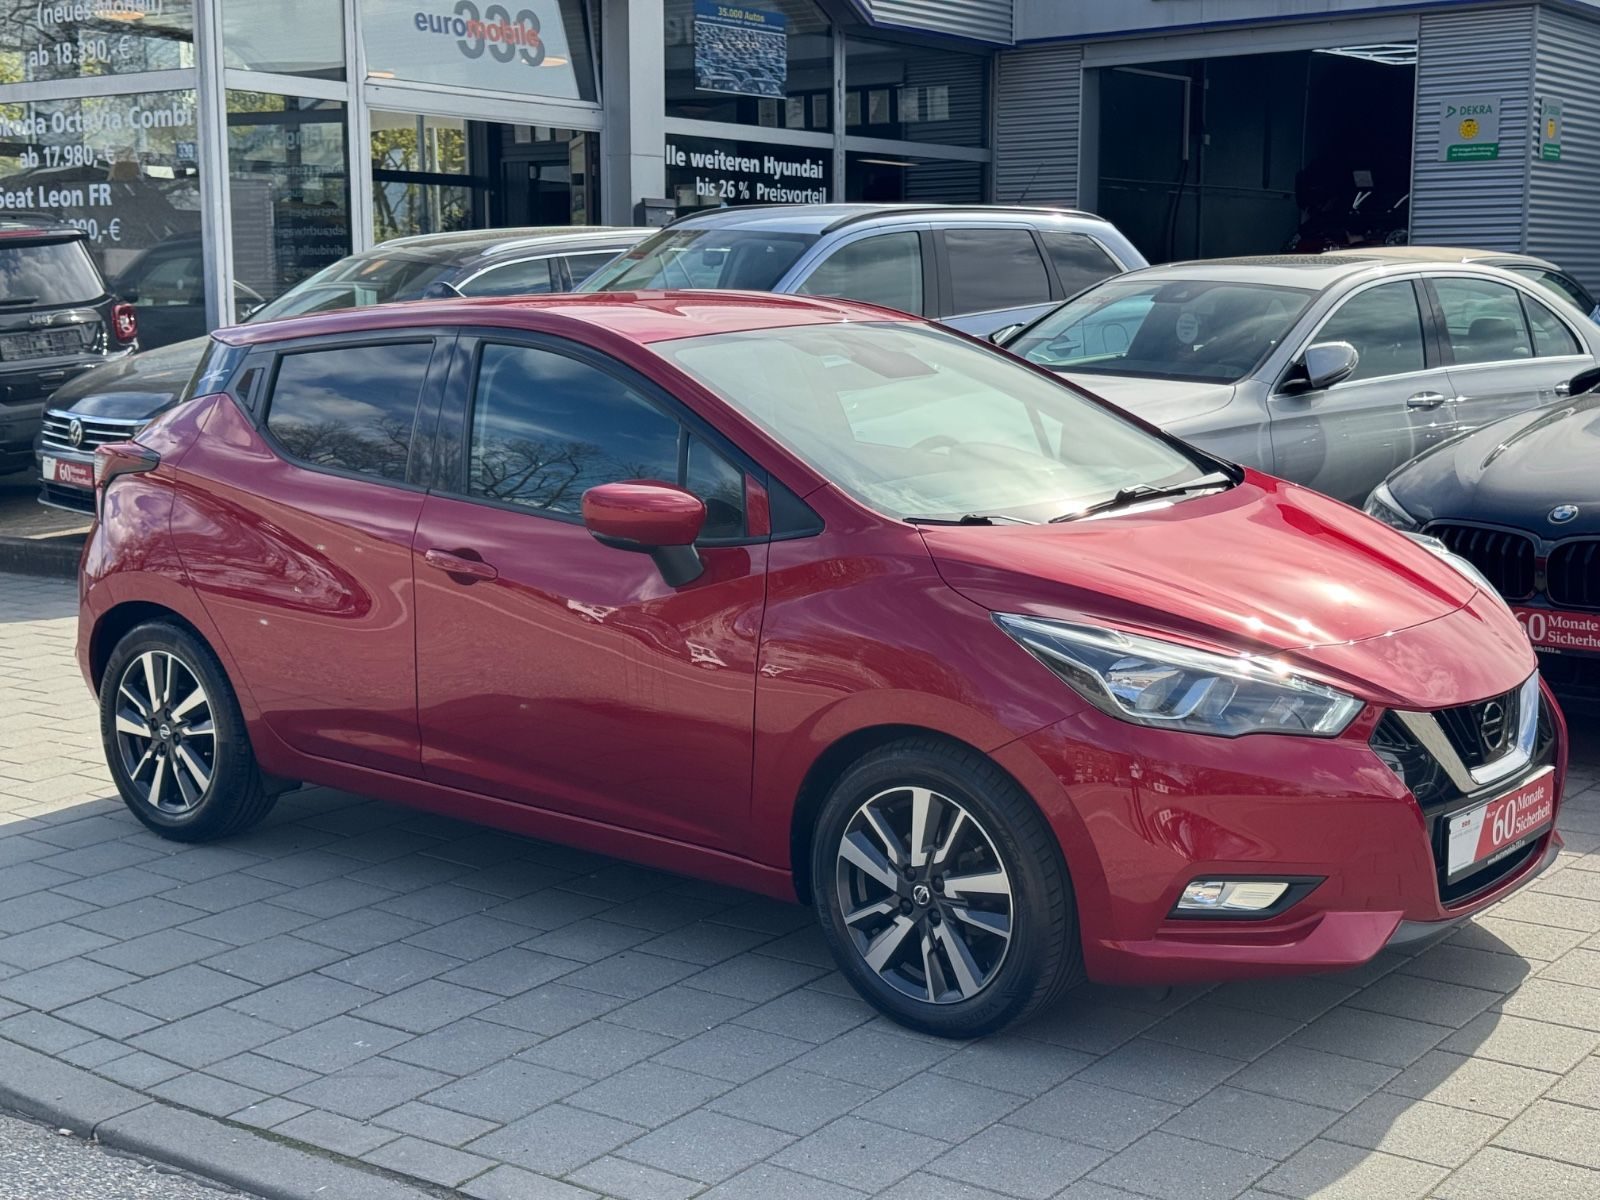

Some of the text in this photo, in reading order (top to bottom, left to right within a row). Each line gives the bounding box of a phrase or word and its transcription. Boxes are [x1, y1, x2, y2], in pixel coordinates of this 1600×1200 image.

[37, 2, 91, 30] (neues
[744, 12, 765, 23] Autos
[453, 0, 546, 67] 333
[29, 44, 49, 66] ab
[0, 103, 192, 137] koda Octavia Combi
[1459, 105, 1493, 117] DEKRA
[20, 147, 38, 168] ab
[665, 144, 823, 180] lle weiteren Hyundai
[39, 185, 83, 208] Leon
[88, 183, 112, 207] FR
[696, 176, 827, 205] bis 26 % Preisvorteil
[59, 464, 71, 482] 60
[1547, 614, 1599, 631] Monate
[1517, 785, 1545, 812] Monate
[1492, 799, 1517, 846] 60
[1515, 801, 1551, 834] Sicherheit
